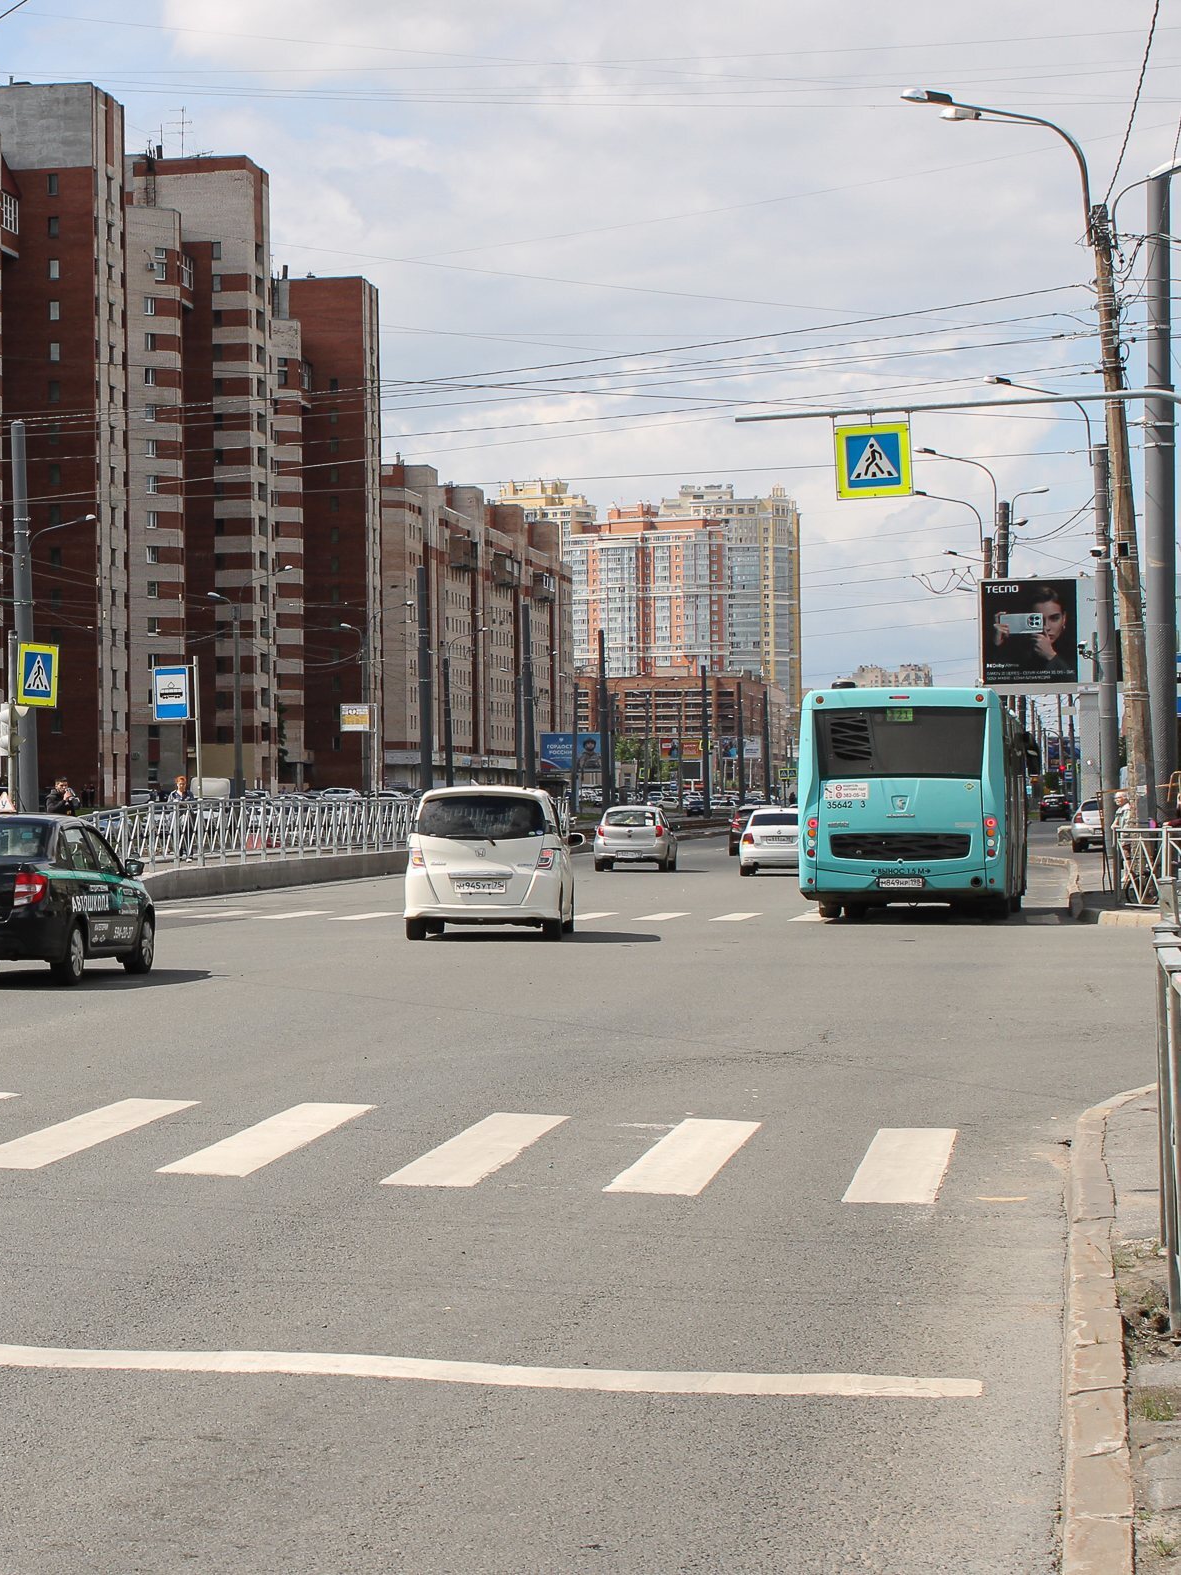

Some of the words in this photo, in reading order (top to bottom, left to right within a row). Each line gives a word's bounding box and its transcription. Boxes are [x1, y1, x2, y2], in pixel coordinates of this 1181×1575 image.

[985, 585, 1019, 594] TECNO
[827, 800, 853, 809] 35642
[860, 800, 866, 808] 3
[71, 895, 110, 912] АВТОШКОЛА
